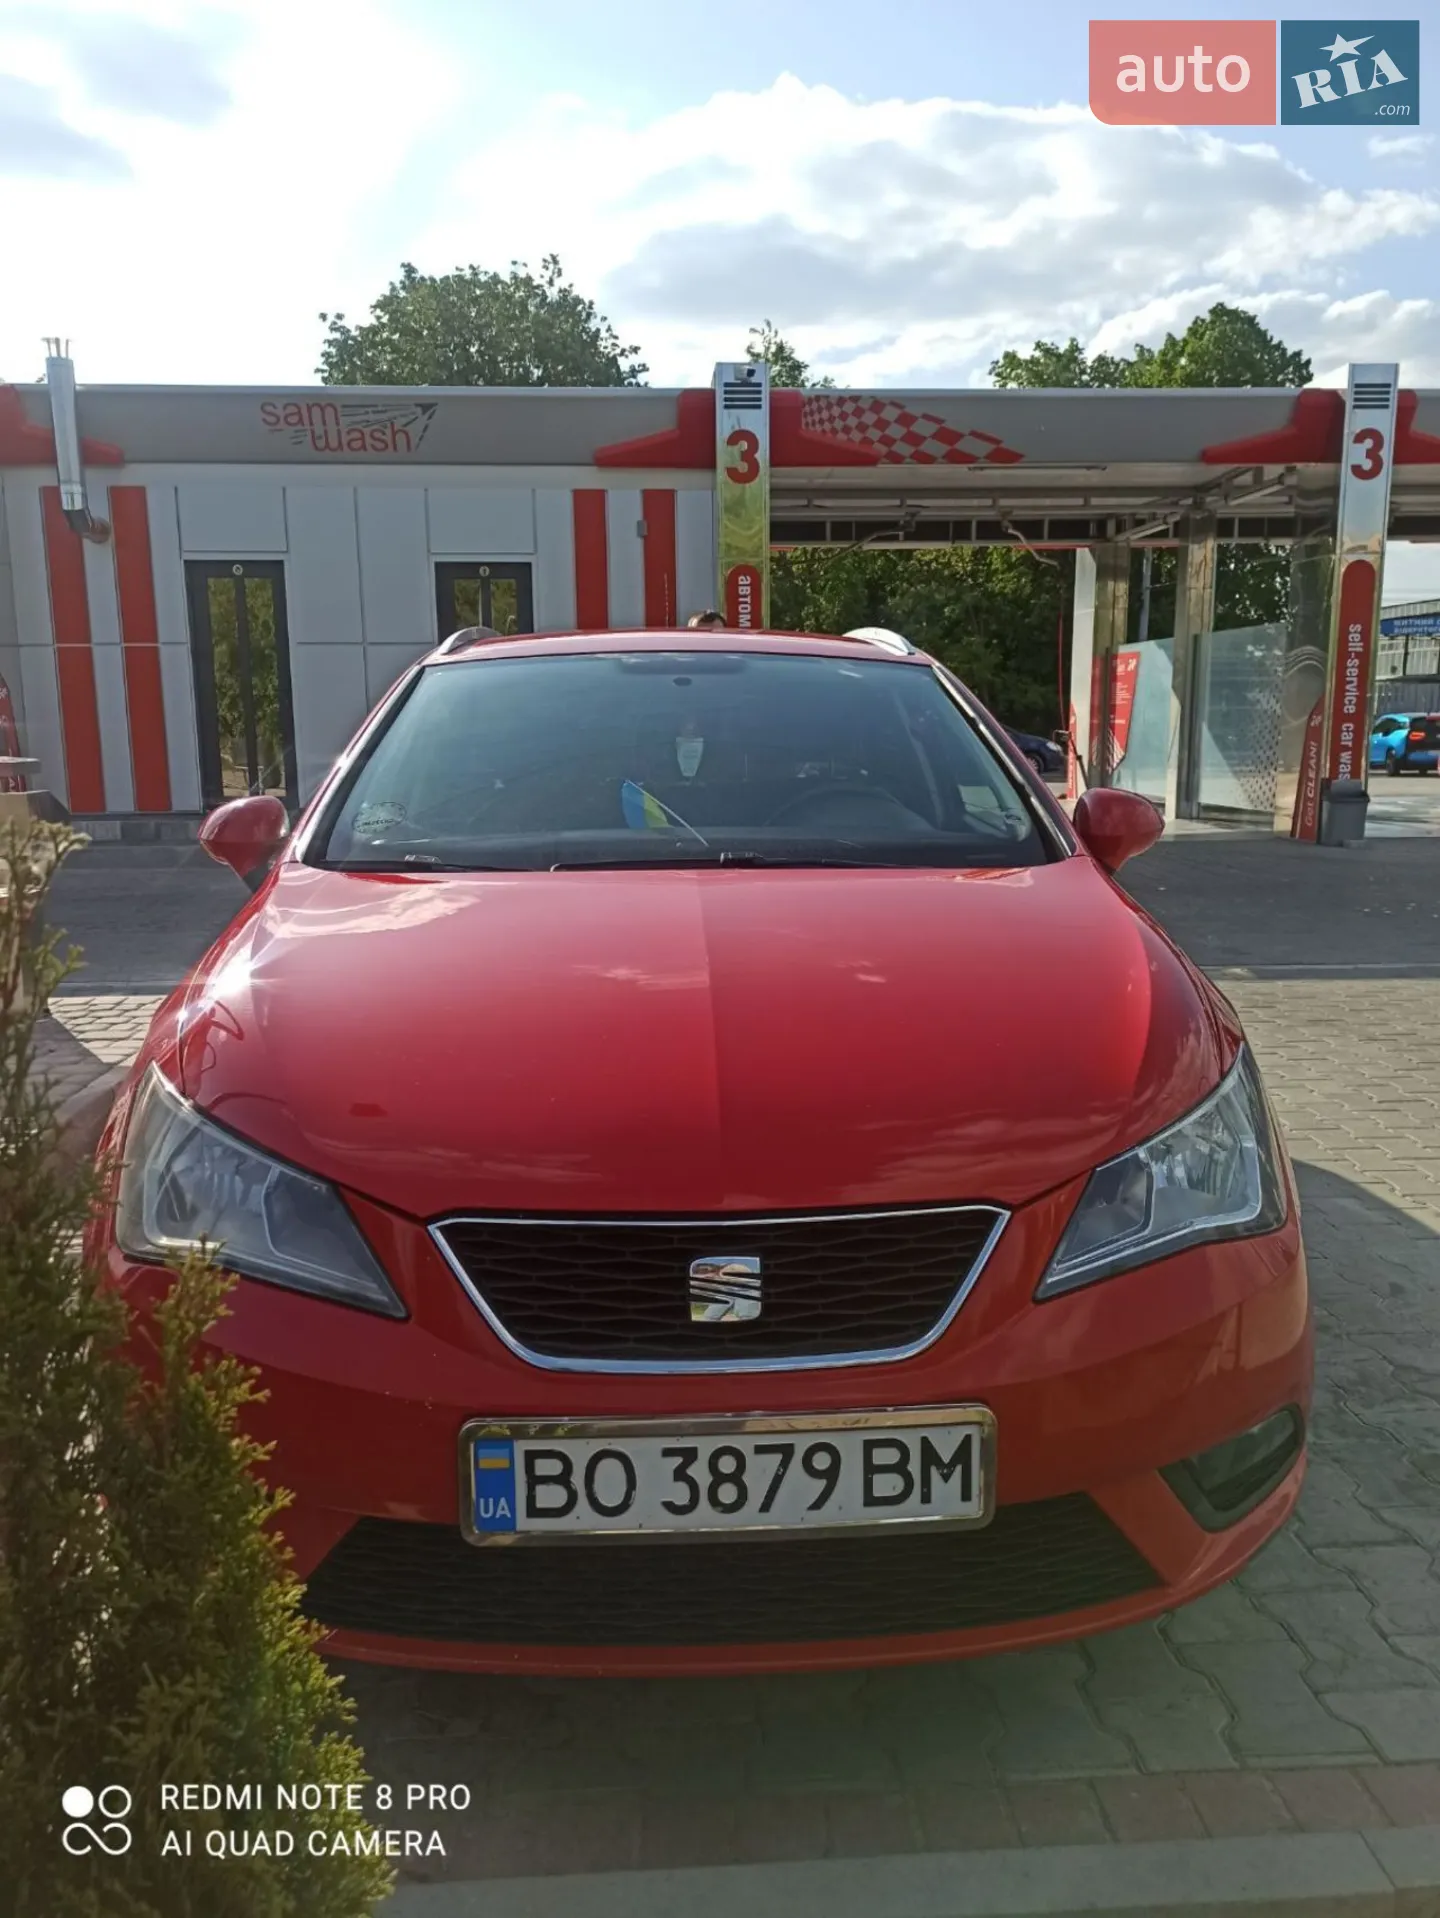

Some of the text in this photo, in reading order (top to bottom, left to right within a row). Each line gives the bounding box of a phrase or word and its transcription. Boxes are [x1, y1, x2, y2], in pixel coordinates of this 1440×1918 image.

[260, 402, 341, 427] sam
[310, 421, 412, 452] wash
[724, 429, 760, 484] 3
[1350, 428, 1385, 480] 3
[1343, 623, 1364, 714] self-service
[1340, 723, 1355, 748] car
[1306, 740, 1318, 798] CLEAN!
[479, 1433, 973, 1519] UA BO 3879 BM
